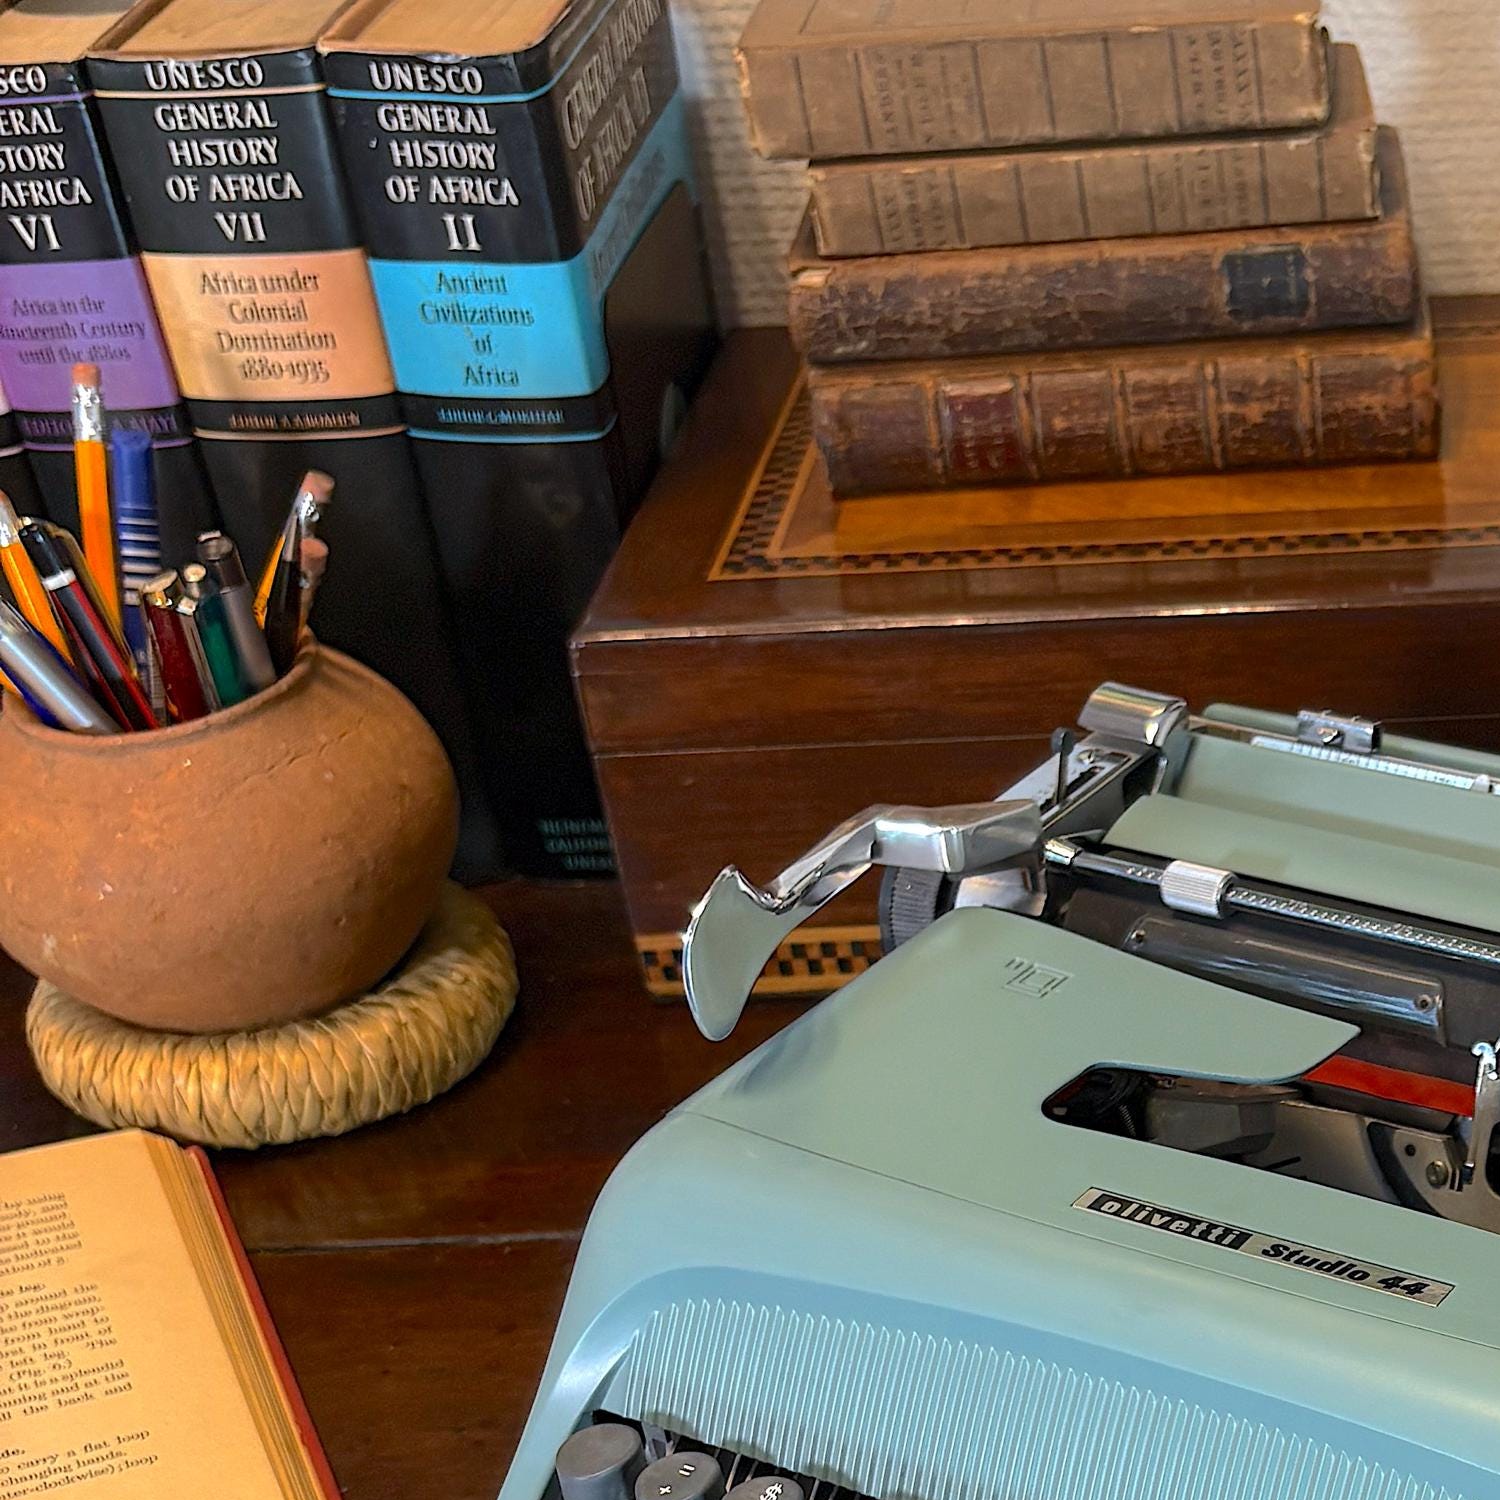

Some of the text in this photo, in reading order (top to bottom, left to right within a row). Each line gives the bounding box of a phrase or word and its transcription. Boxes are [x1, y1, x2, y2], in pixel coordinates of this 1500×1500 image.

[145, 59, 264, 90] UNESCO
[369, 61, 483, 94] UNESCO
[155, 101, 278, 132] GENERAL
[377, 103, 497, 134] GENERAL
[167, 137, 279, 167] HISTORY
[389, 140, 496, 170] HISTORY
[0, 176, 93, 208] AFRICA
[165, 171, 303, 203] OF AFRICA
[385, 176, 520, 206] OF AFRICA
[8, 214, 62, 250] VI
[214, 212, 268, 242] VII
[442, 213, 482, 251] II
[200, 270, 319, 294] Africa under
[436, 272, 507, 294] Ancient
[229, 301, 309, 323] Colonial
[420, 303, 534, 325] Civilizations
[217, 330, 337, 352] Domination
[474, 335, 493, 354] of
[463, 365, 519, 386] Africa
[1101, 1198, 1430, 1297] olivetti Studio 44
